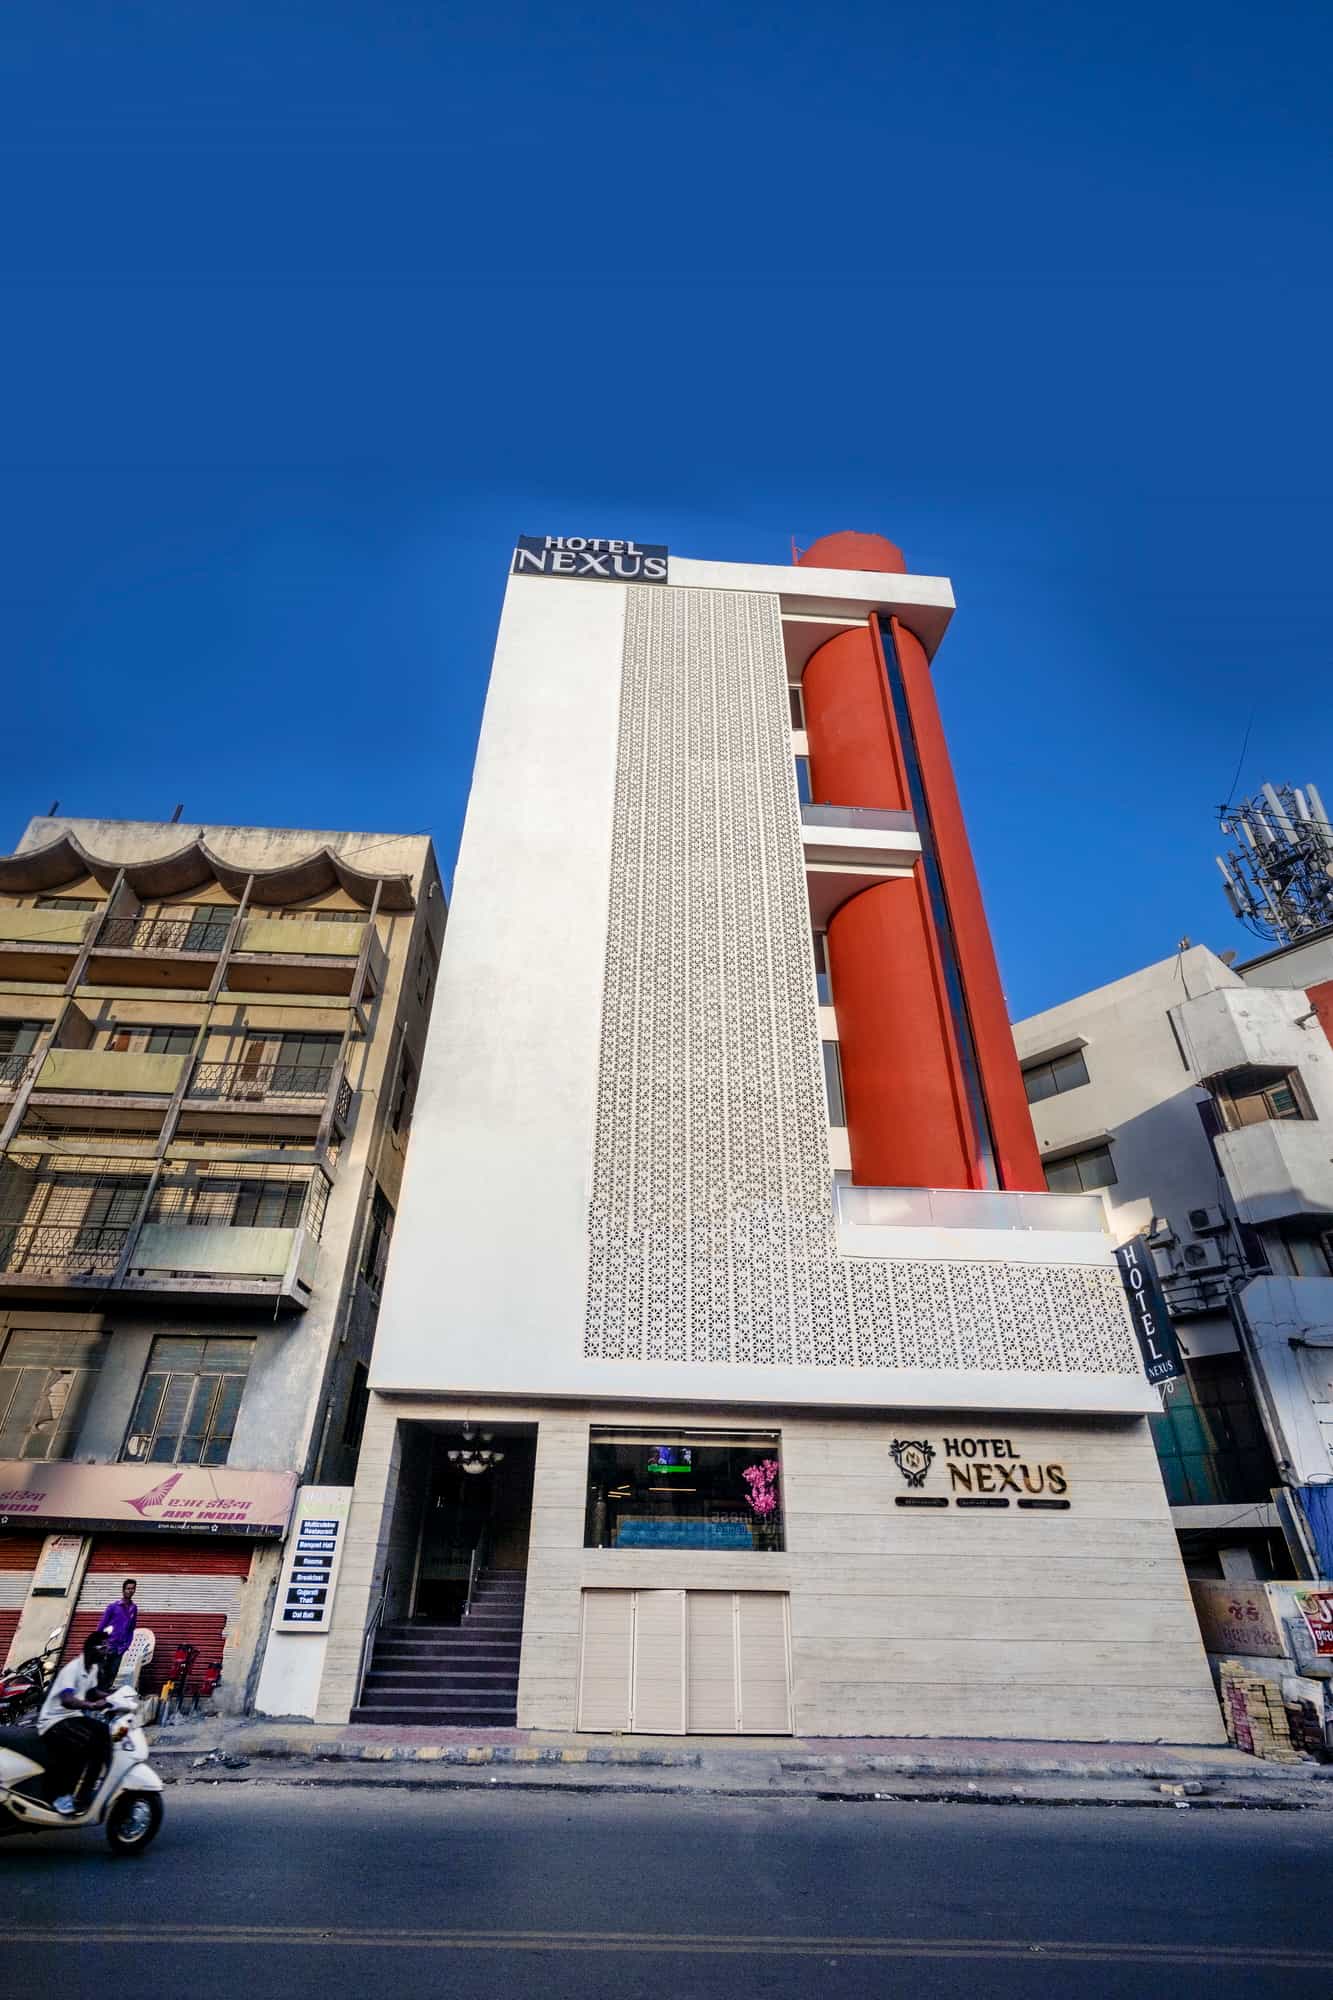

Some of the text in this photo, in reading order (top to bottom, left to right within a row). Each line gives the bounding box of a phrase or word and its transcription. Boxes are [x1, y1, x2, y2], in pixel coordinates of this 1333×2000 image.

[545, 535, 643, 555] HOTEL
[516, 548, 667, 579] NEXUS
[1123, 1245, 1162, 1360] HOTEL
[1148, 1359, 1174, 1377] NEXUS
[943, 1438, 1020, 1458] HOTEL
[946, 1462, 1068, 1494] NEXUS
[161, 1510, 247, 1521] AIR INDIA
